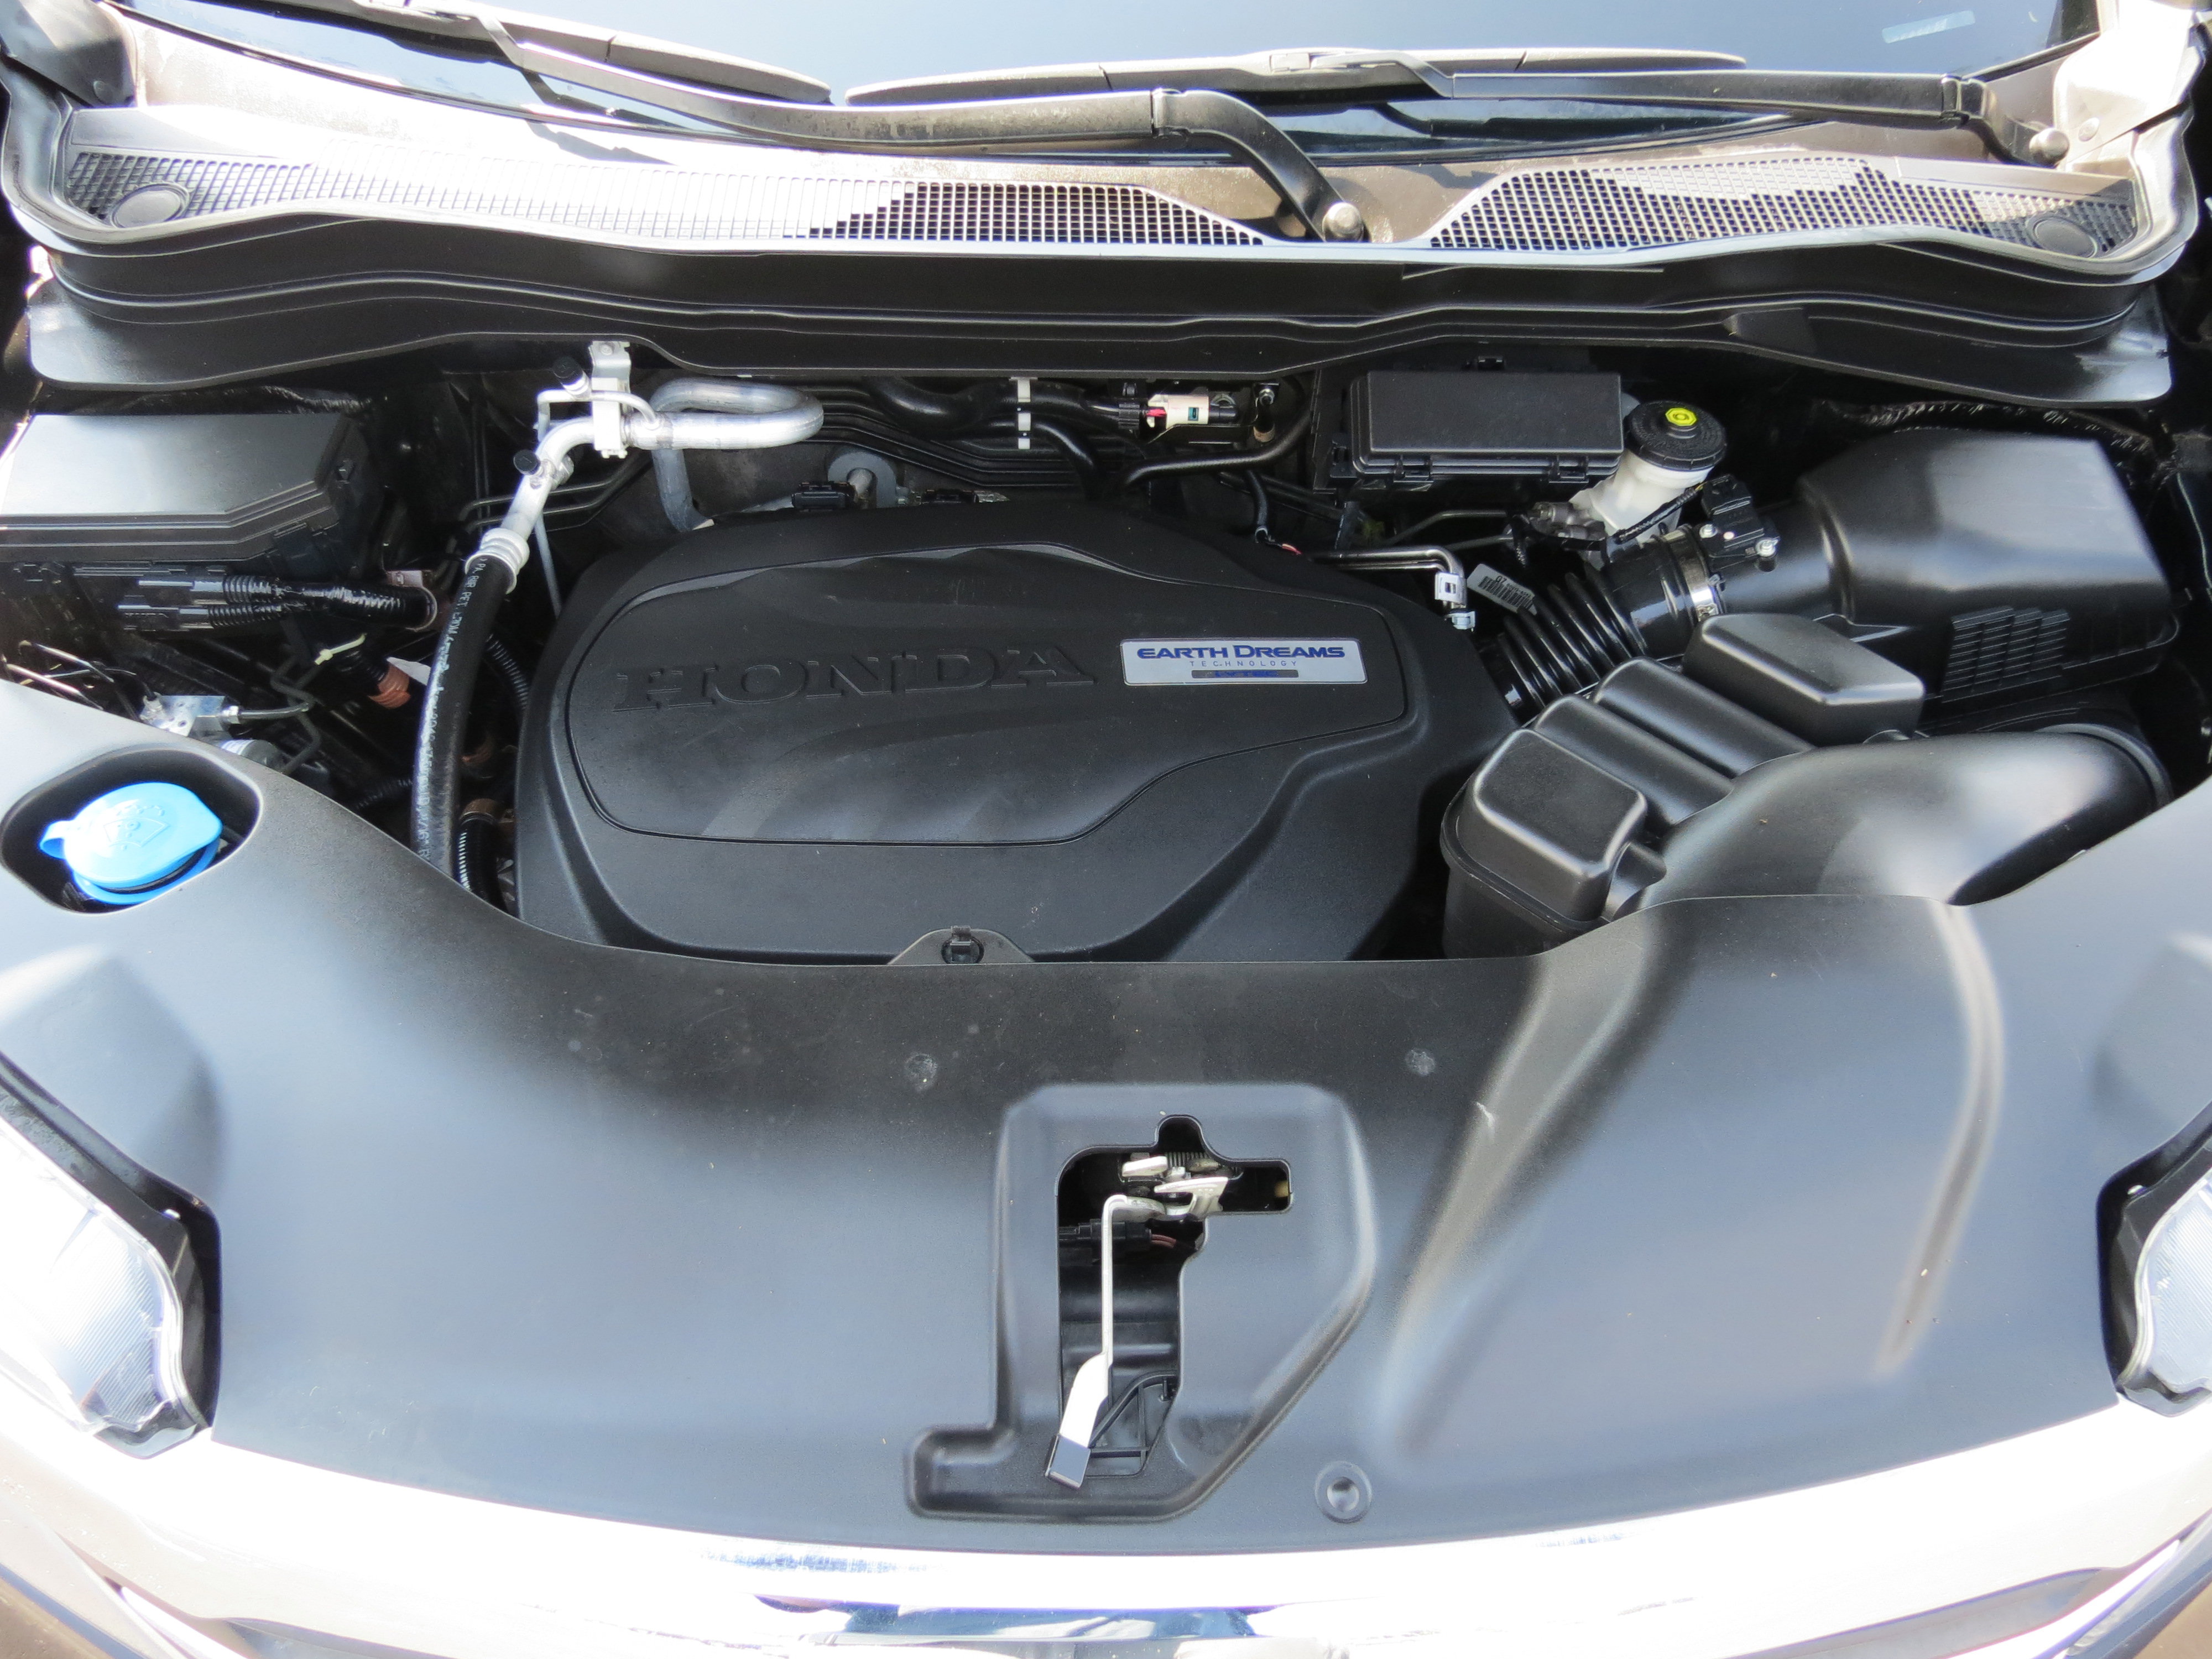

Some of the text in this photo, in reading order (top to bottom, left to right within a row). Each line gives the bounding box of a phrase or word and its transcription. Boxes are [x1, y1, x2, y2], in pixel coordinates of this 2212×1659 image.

[1136, 645, 1345, 659] EARTH DREAMS
[612, 643, 1097, 712] HONDA
